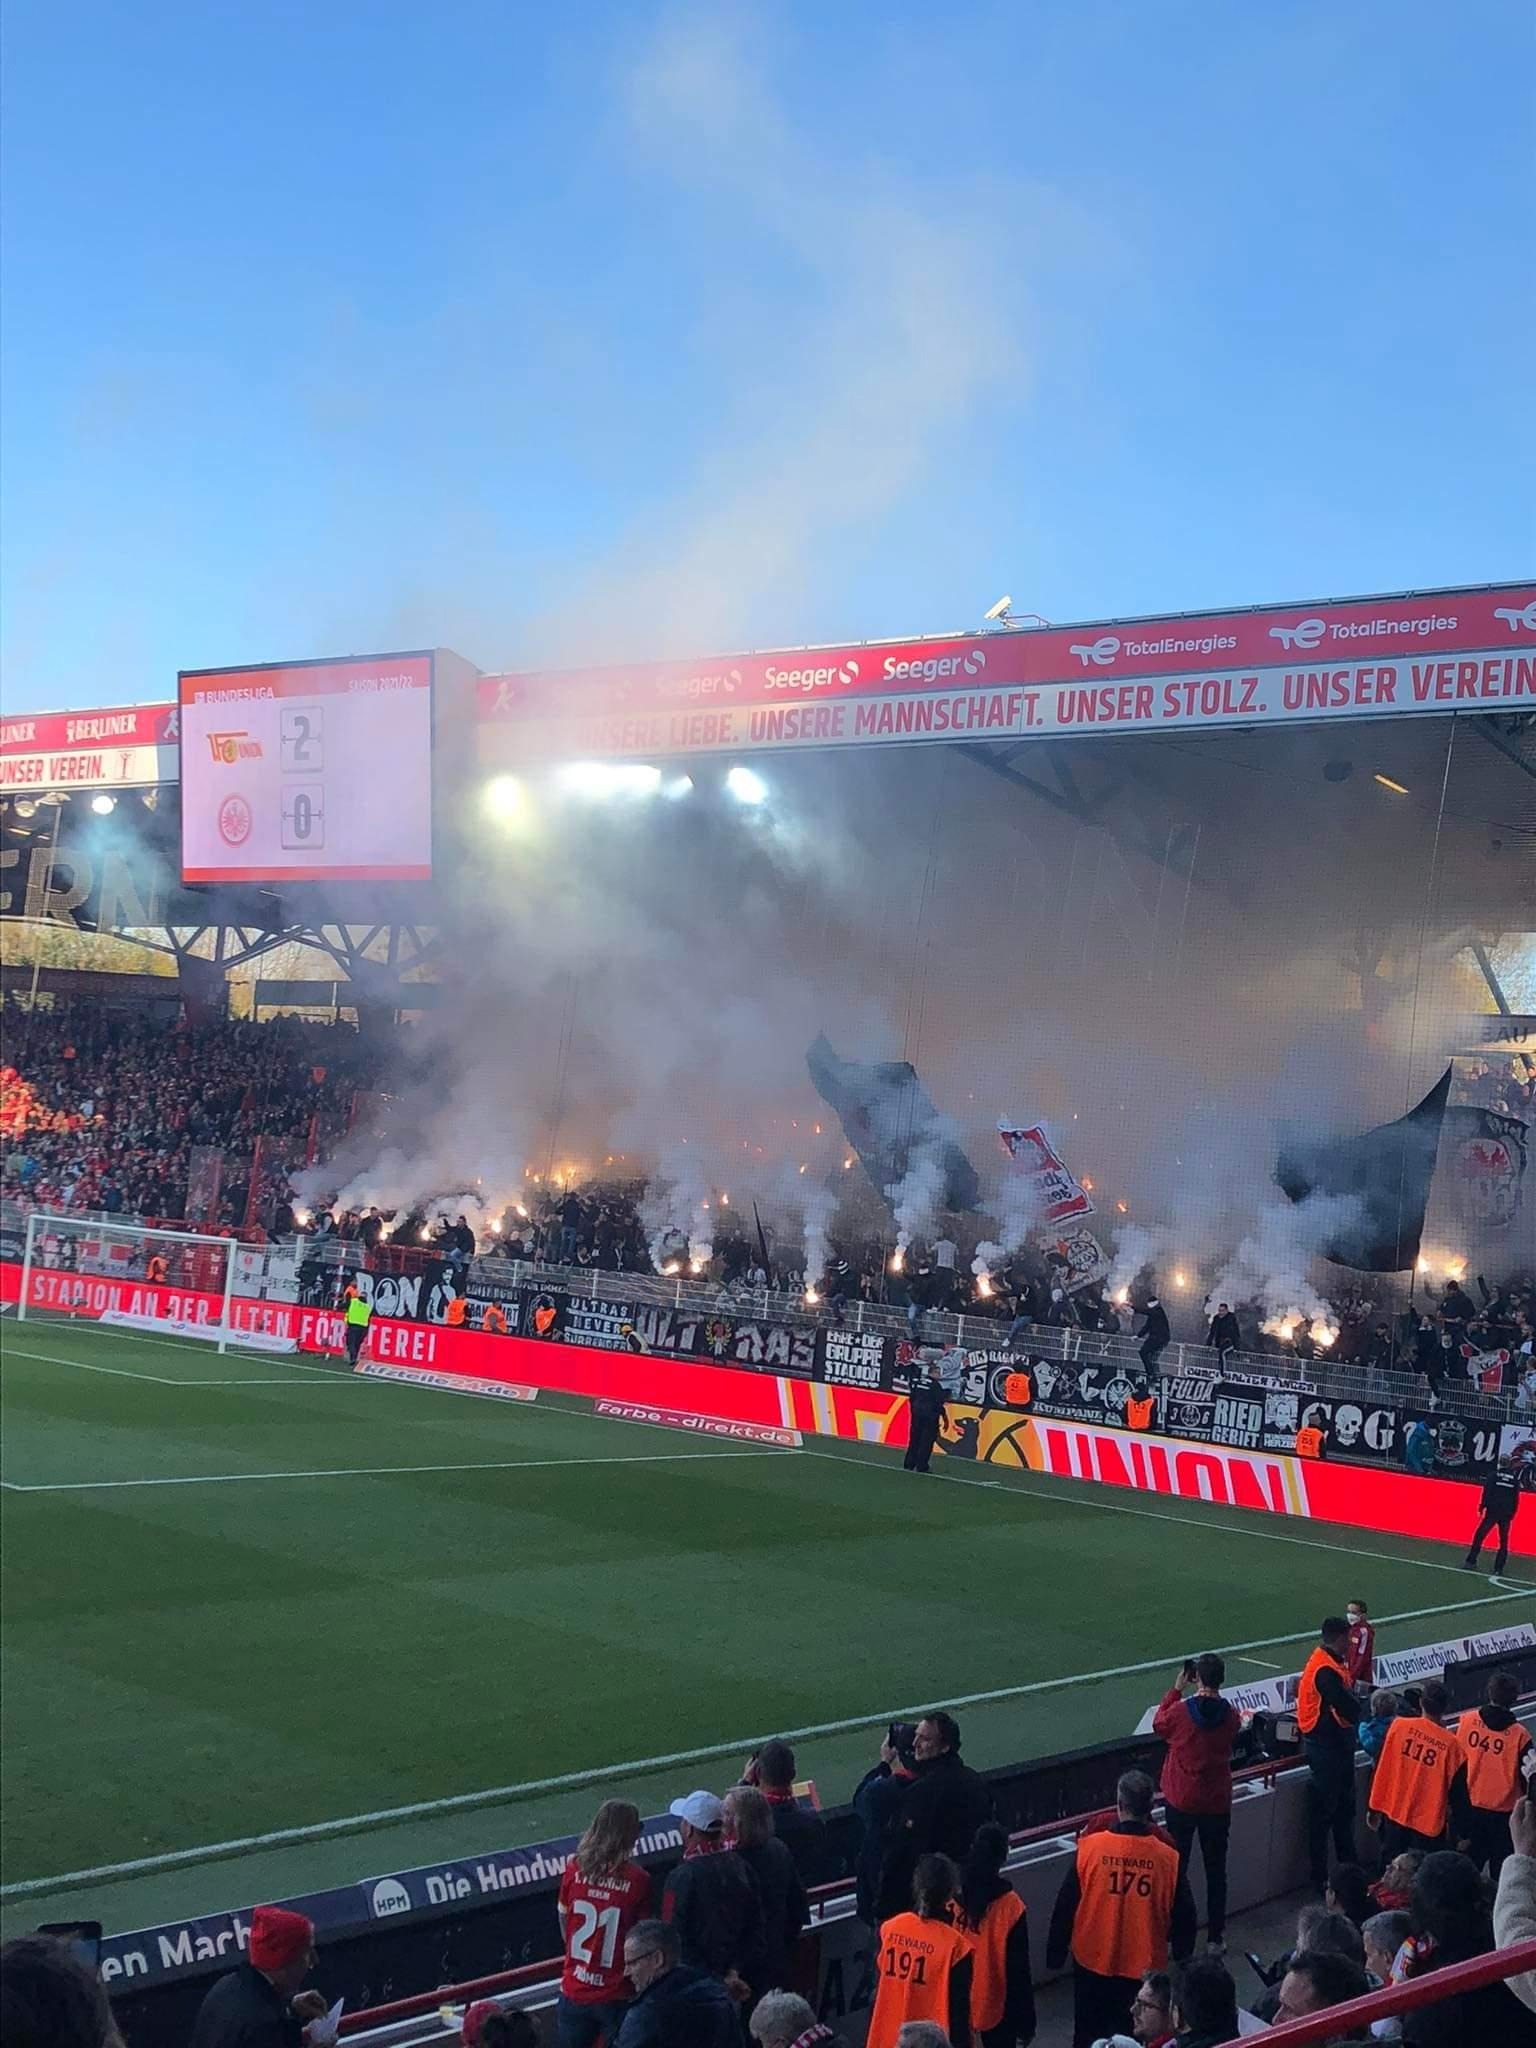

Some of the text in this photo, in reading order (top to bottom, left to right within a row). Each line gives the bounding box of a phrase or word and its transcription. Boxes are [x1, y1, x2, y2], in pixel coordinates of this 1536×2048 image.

[1330, 613, 1458, 640] TotalEnergies
[1123, 633, 1237, 657] TotalEnergies
[765, 665, 836, 692] Seeger
[883, 656, 961, 682] Seeger
[206, 687, 274, 704] BUNDESLIGA
[668, 712, 739, 746] LIEBE.
[750, 704, 846, 741] UNSERE
[854, 689, 1043, 737] MANNSCHAFT.
[1056, 685, 1153, 725] UNSER
[1162, 677, 1268, 718] STOLZ.
[1282, 666, 1397, 710] UNSER
[0, 722, 36, 746] LINER
[76, 714, 137, 740] BERLINER
[293, 715, 310, 761] 2
[50, 755, 106, 781] VEREIN.
[294, 793, 311, 840] 0
[130, 1289, 158, 1319] AN
[571, 1296, 629, 1317] ULTRAS
[826, 1343, 882, 1367] GRUPPE
[363, 1364, 520, 1398] kfzteile24.de
[825, 1361, 881, 1382] STADION
[1170, 1378, 1214, 1401] FULDA
[1214, 1399, 1263, 1433] RIED
[1211, 1425, 1260, 1448] GEBIET
[1407, 1727, 1447, 1751] STEWARD
[1468, 1730, 1505, 1755] 049
[1401, 1738, 1436, 1767] 118
[1102, 1856, 1154, 1871] STEWARD
[425, 1871, 471, 1904] Die
[476, 1851, 575, 1893] Handw
[1108, 1871, 1152, 1897] 176
[376, 1894, 407, 1912] HPM
[570, 1899, 621, 1969] 21
[887, 1933, 935, 1955] STEWARD
[101, 1951, 149, 1983] en
[884, 1946, 926, 1985] 191
